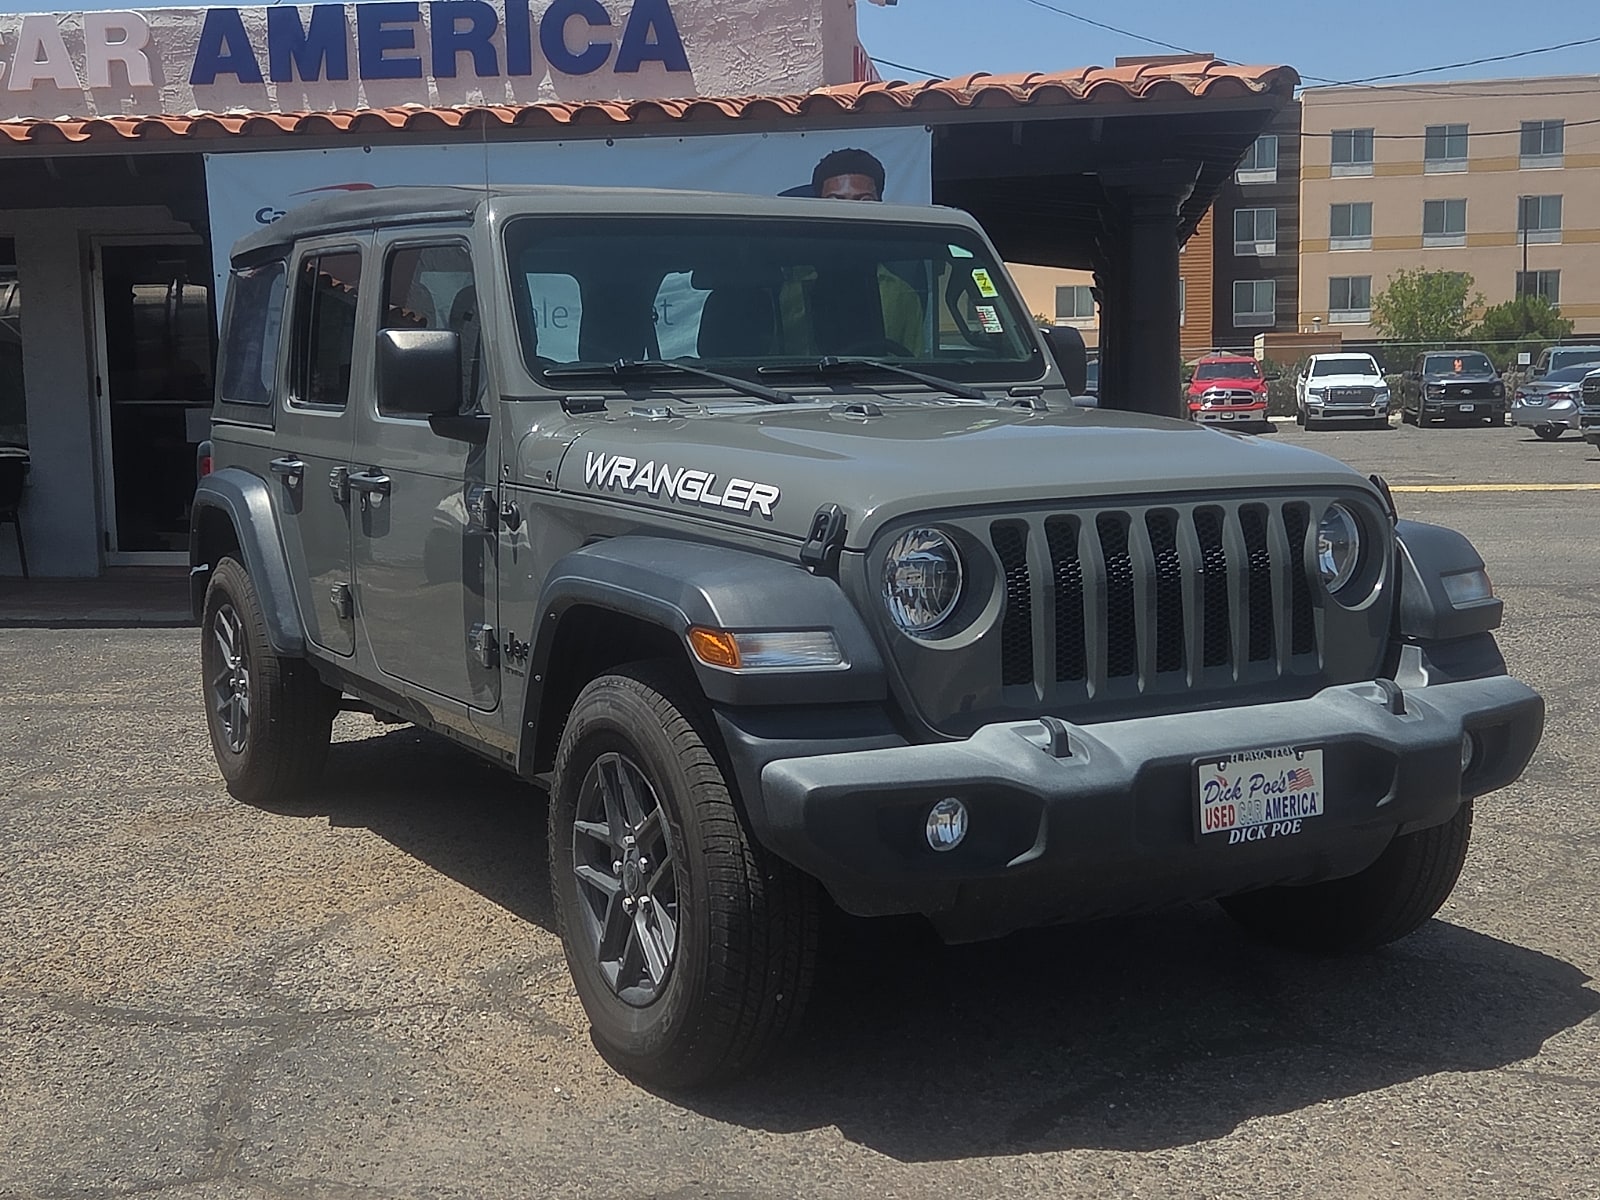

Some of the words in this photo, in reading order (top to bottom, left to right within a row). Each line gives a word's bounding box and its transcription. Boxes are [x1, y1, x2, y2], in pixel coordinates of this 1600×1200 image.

[0, 10, 153, 91] AR
[189, 0, 692, 85] AMERICA
[585, 451, 781, 519] WRANGLER
[1203, 776, 1243, 805] Dick
[1248, 771, 1288, 798] Poe's
[1205, 804, 1236, 830] USED
[1239, 799, 1263, 826] CAR
[1265, 792, 1318, 821] AMERICA
[1228, 825, 1267, 845] DICK
[1270, 819, 1302, 838] POE
